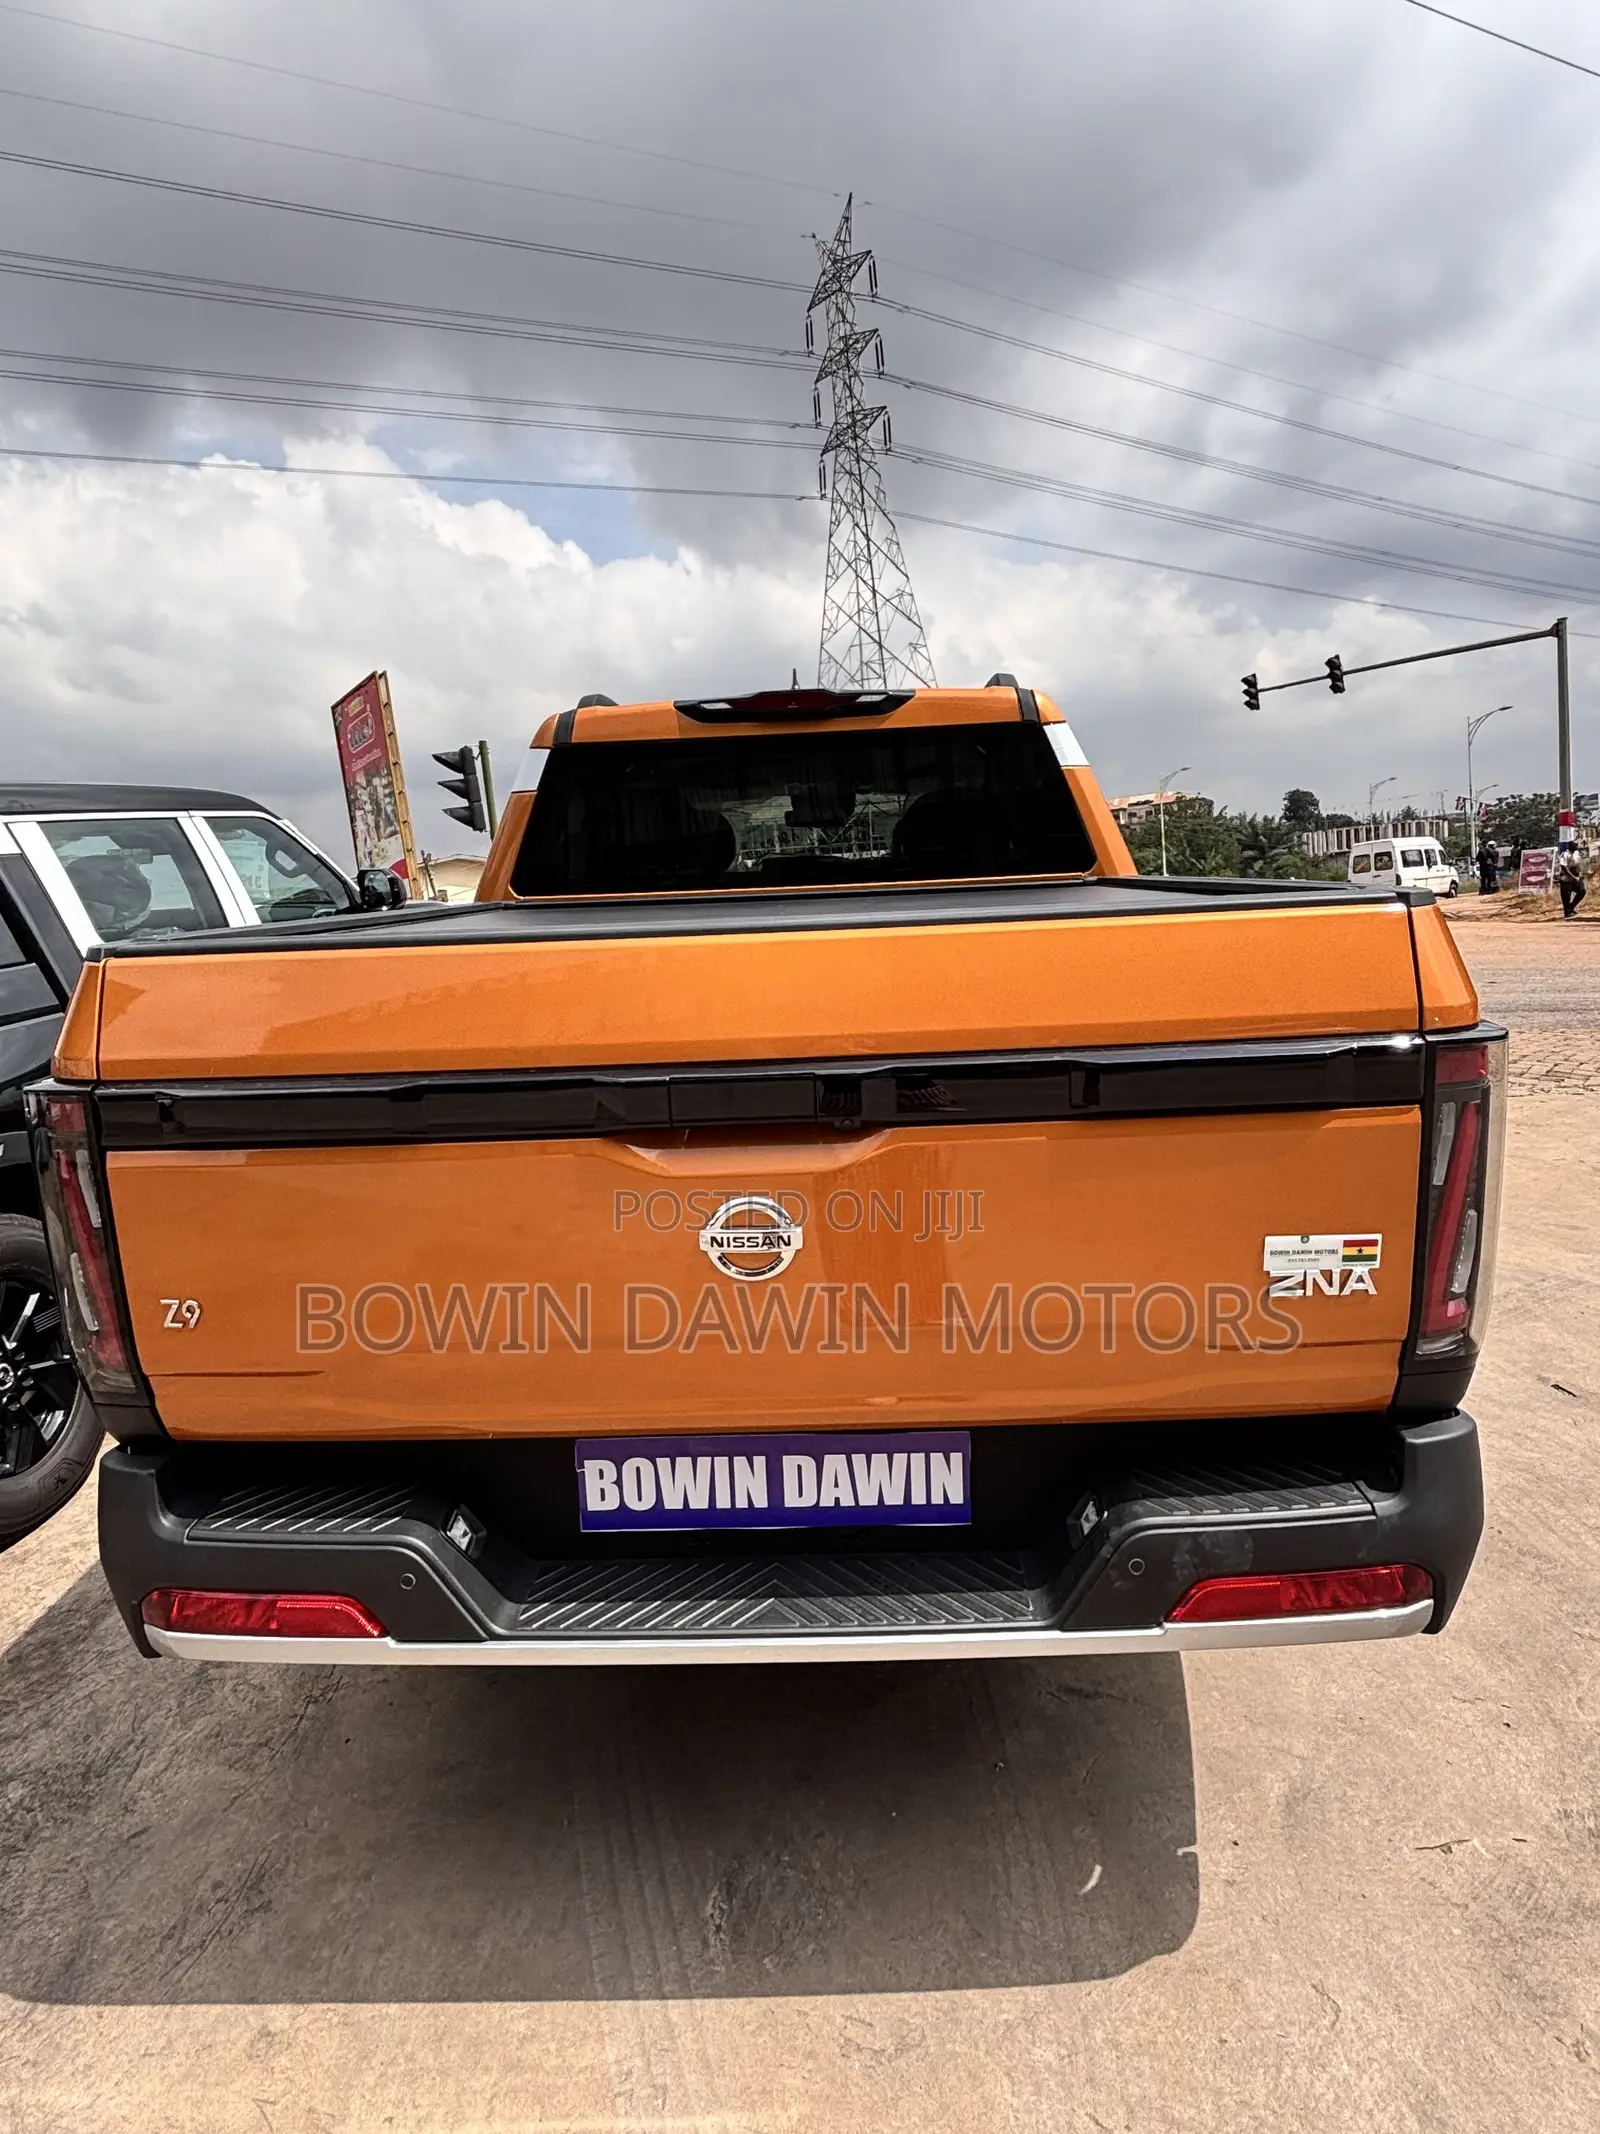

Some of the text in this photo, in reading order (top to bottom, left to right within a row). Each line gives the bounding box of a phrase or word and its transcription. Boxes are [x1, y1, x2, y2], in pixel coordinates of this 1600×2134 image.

[709, 1234, 792, 1249] NISSAN
[1269, 1267, 1378, 1297] ZNA
[159, 1299, 201, 1329] Z9
[583, 1452, 965, 1512] BOWIN DAWIN
